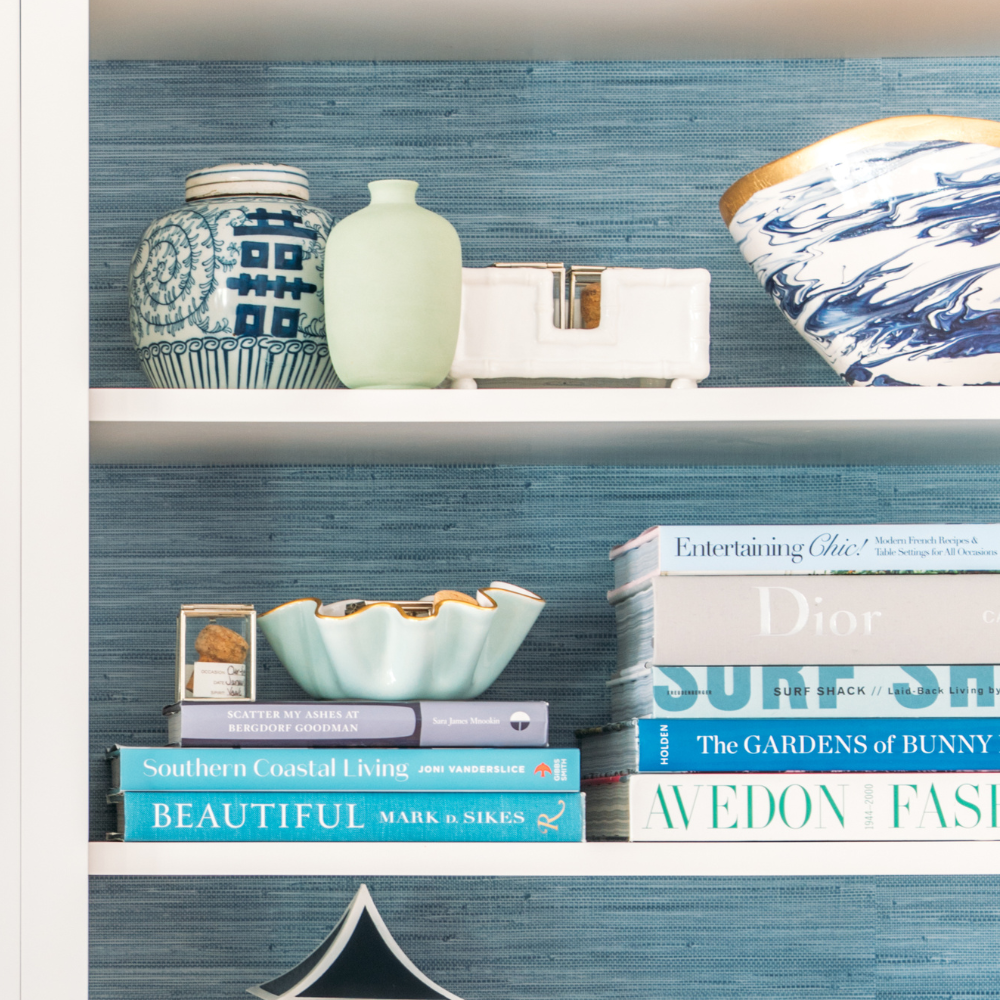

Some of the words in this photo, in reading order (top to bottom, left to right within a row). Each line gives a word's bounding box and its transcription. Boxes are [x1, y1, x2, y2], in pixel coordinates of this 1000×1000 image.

[674, 536, 805, 564] Entertaining
[808, 532, 870, 558] Chic!
[875, 536, 907, 545] Modern
[908, 536, 938, 545] French
[939, 536, 970, 547] Recipes
[874, 548, 897, 557] Table
[898, 548, 930, 559] Settings
[931, 548, 944, 557] for
[944, 548, 956, 557] All
[957, 547, 998, 556] Occasions
[750, 585, 882, 638] Dior
[773, 687, 811, 696] SURF
[816, 686, 866, 696] SHACK
[888, 686, 945, 695] Laid-Back
[949, 686, 984, 696] Living
[227, 710, 281, 719] SCATTER
[284, 710, 302, 719] MY
[305, 710, 343, 719] ASHES
[345, 710, 360, 719] AT
[432, 717, 447, 725] Sara
[447, 717, 469, 726] James
[228, 723, 293, 733] BERGDORF
[295, 723, 359, 733] GOODMAN
[660, 724, 669, 765] HOLDEN
[697, 735, 738, 754] The
[743, 734, 868, 755] GARDENS
[873, 734, 897, 754] of
[902, 734, 993, 754] BUNNY
[142, 757, 247, 777] Southern
[253, 757, 336, 777] Coastal
[344, 758, 410, 782] Living
[418, 765, 445, 774] JONI
[448, 765, 526, 774] VANDERSLICE
[553, 758, 561, 782] GIBBS
[151, 802, 365, 829] BEAUTIFUL
[379, 811, 440, 824] MARK
[463, 811, 525, 824] SIKES
[642, 782, 850, 831] AVEDON
